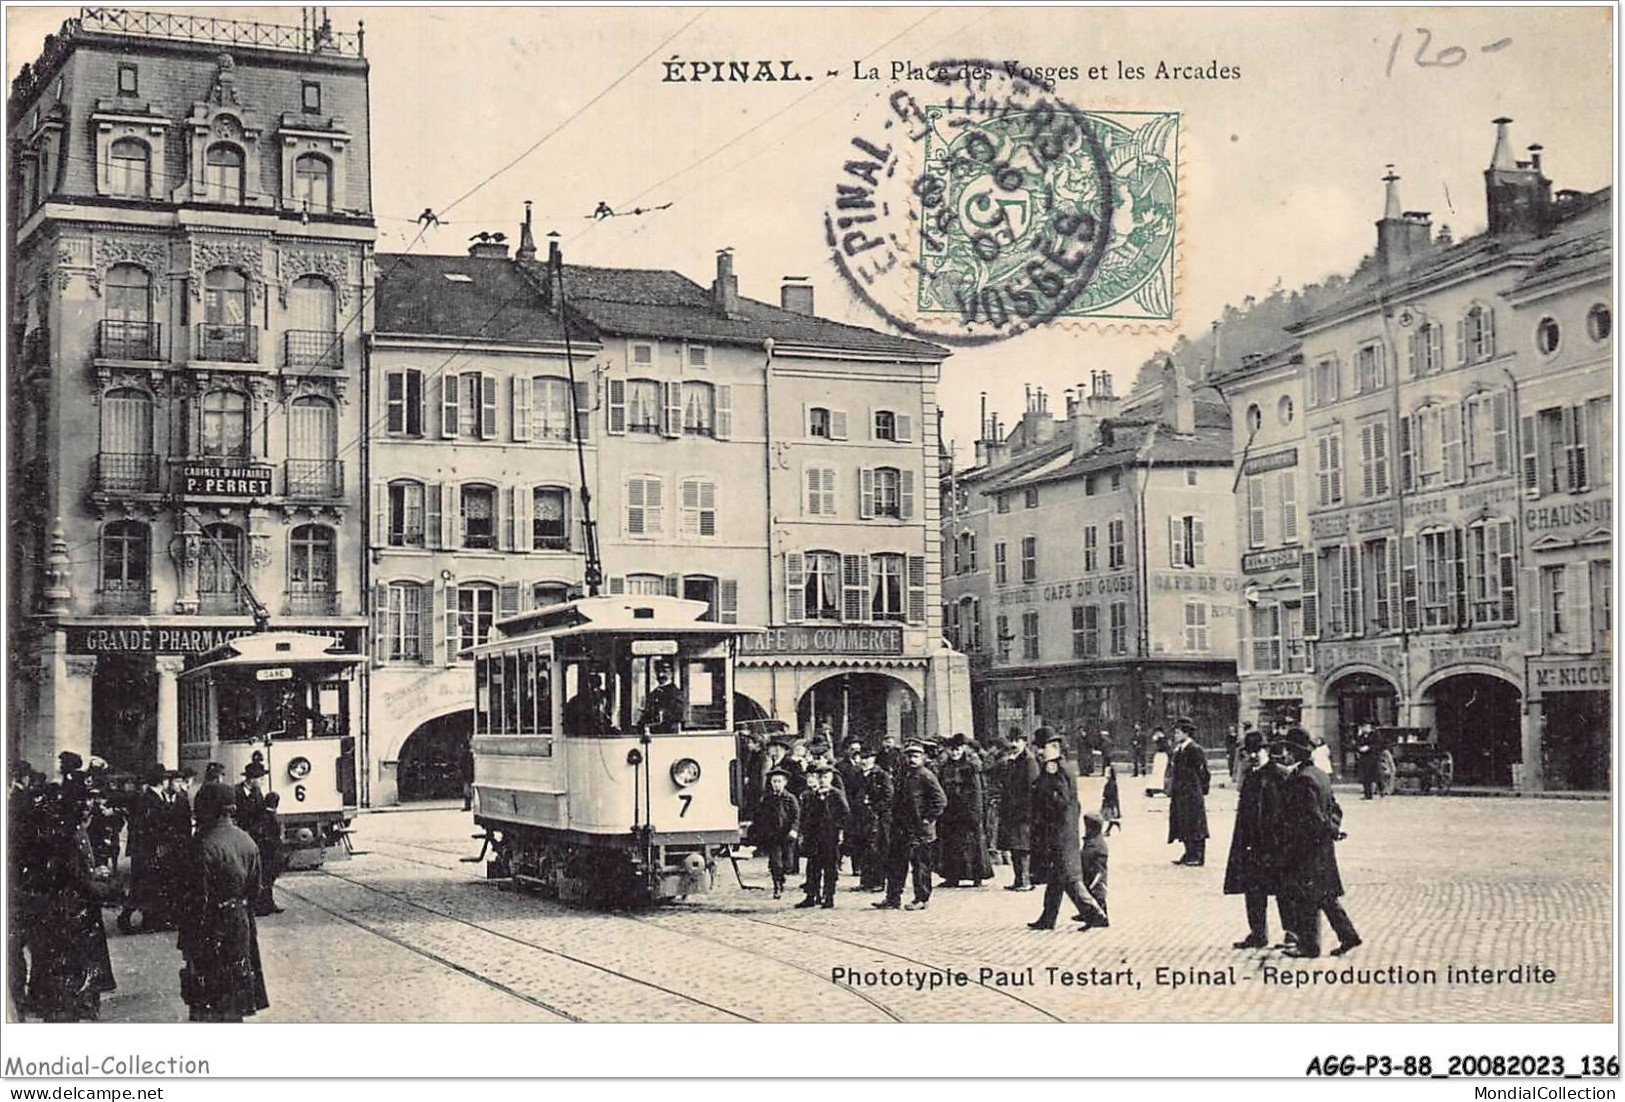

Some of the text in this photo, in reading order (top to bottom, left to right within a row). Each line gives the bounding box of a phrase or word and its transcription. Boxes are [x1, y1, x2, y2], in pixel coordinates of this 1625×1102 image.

[206, 479, 268, 493] PERRET
[1525, 498, 1612, 531] CHAUSSU
[86, 630, 153, 650] GRANDE
[813, 629, 899, 651] COMMERCE
[295, 784, 306, 802] 6
[678, 794, 693, 818] 7
